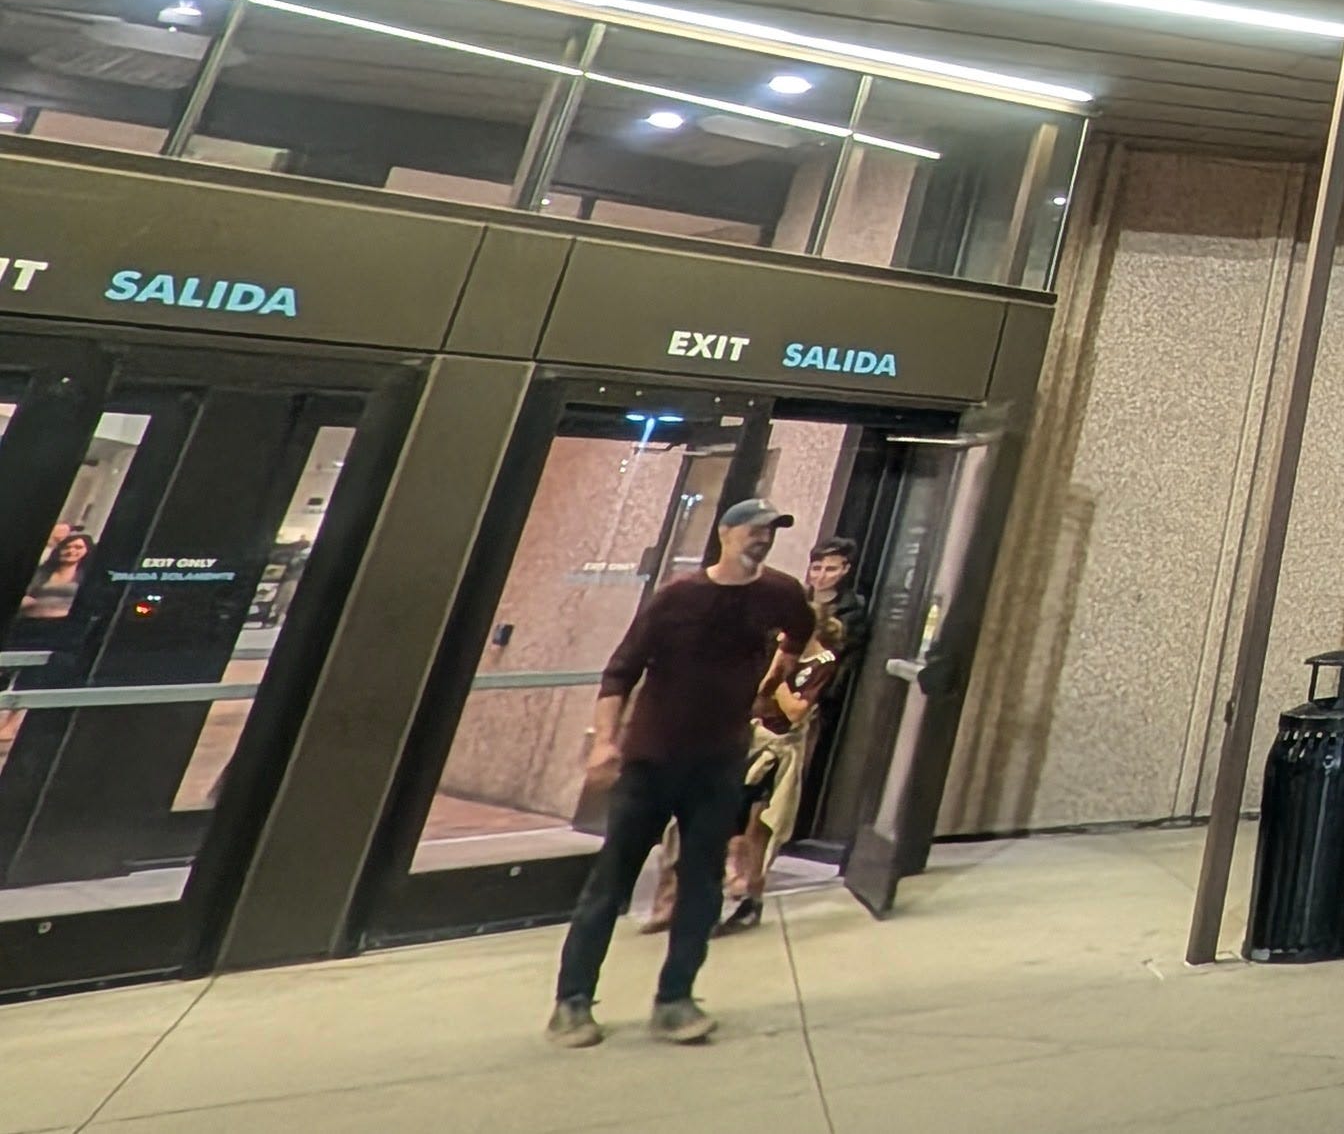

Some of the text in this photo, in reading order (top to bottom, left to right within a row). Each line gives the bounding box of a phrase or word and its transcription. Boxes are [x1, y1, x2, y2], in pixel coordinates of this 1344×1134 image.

[104, 270, 297, 317] SALIDA
[667, 330, 897, 377] EXIT SALIDA
[141, 557, 218, 569] EXIT ONLY
